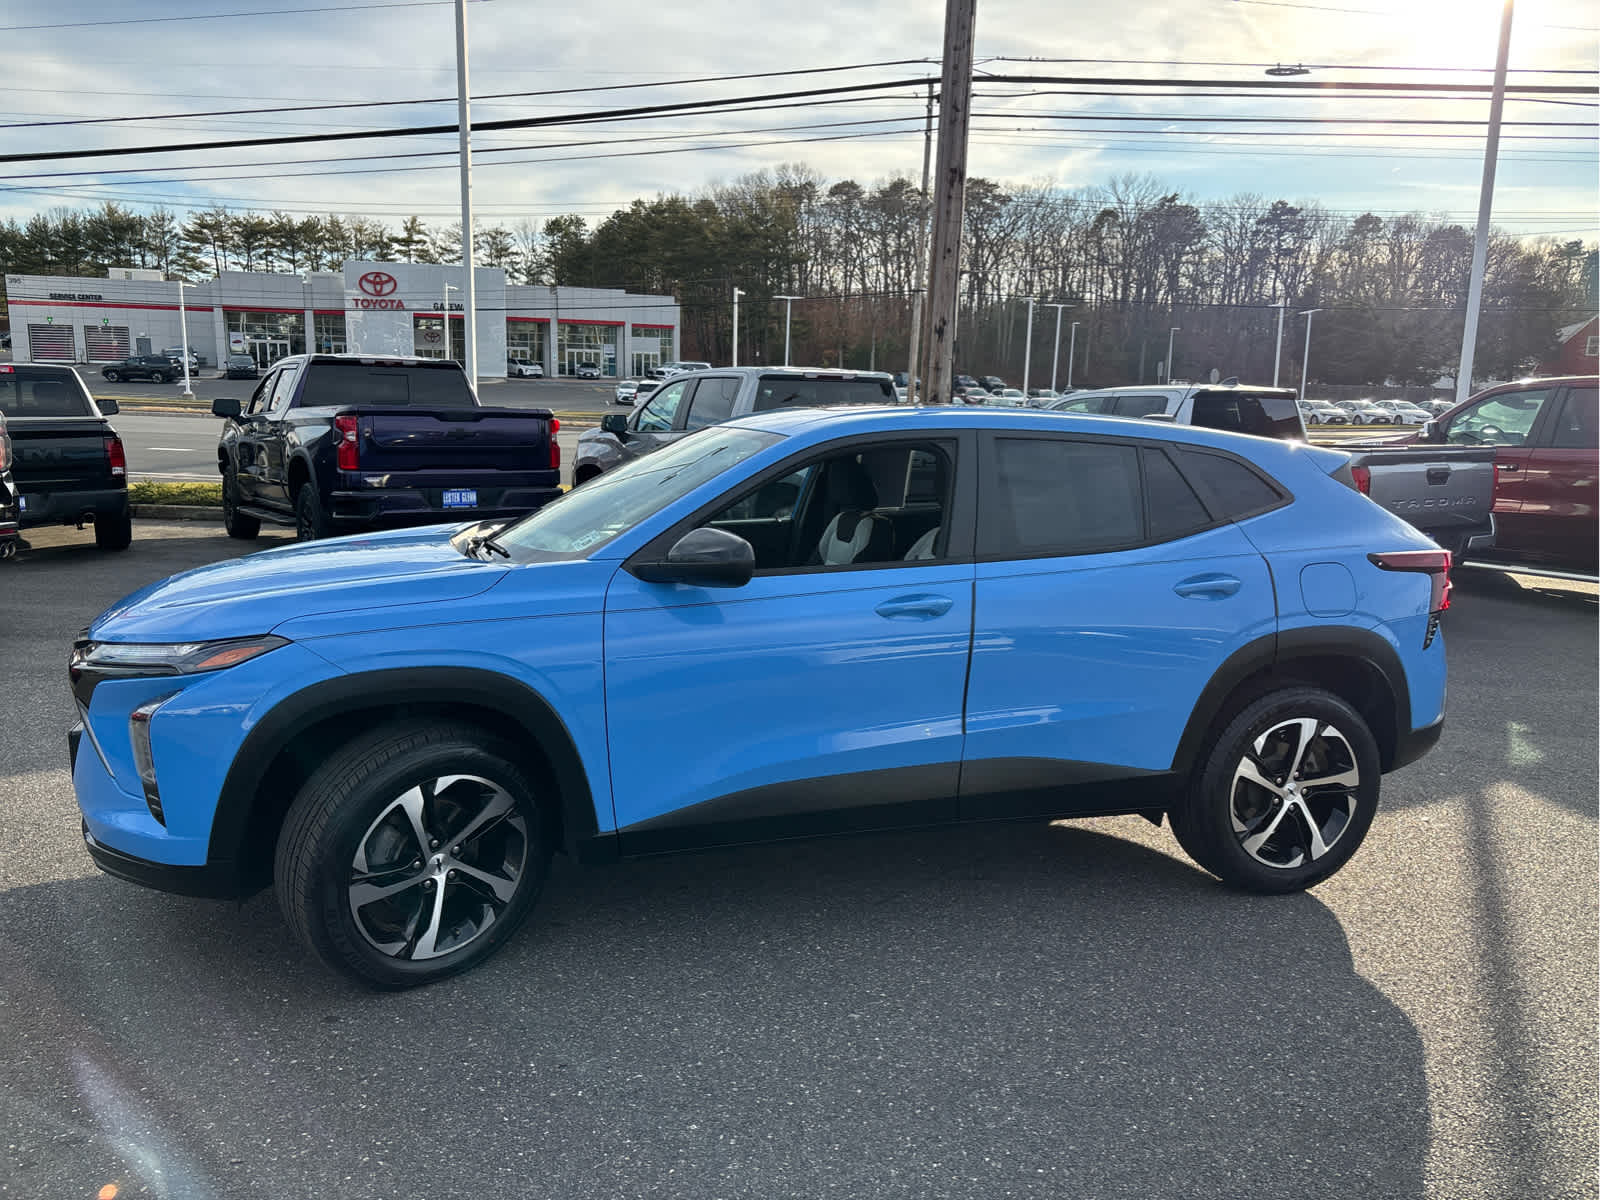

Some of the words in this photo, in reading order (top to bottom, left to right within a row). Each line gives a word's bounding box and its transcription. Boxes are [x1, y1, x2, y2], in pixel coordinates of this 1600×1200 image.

[352, 298, 406, 310] TOYOTA
[433, 302, 465, 311] GAEW
[1392, 497, 1477, 510] TACOMA
